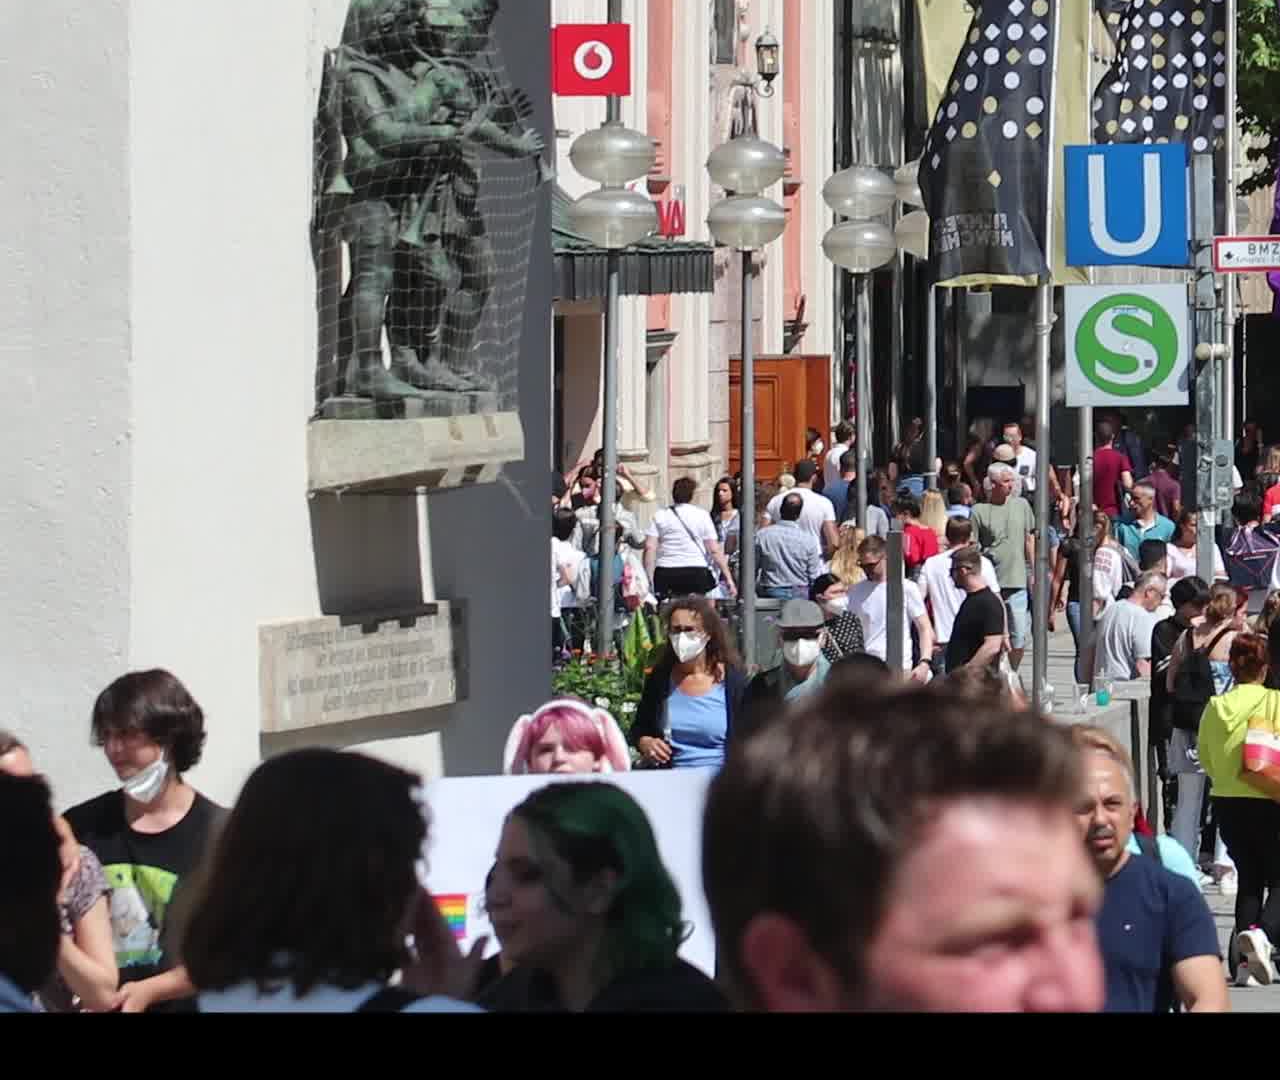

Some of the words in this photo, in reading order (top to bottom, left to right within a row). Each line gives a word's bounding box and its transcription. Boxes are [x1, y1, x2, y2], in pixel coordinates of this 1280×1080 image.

[1087, 153, 1162, 257] U
[1247, 242, 1280, 255] BMZ
[1093, 304, 1160, 384] S
